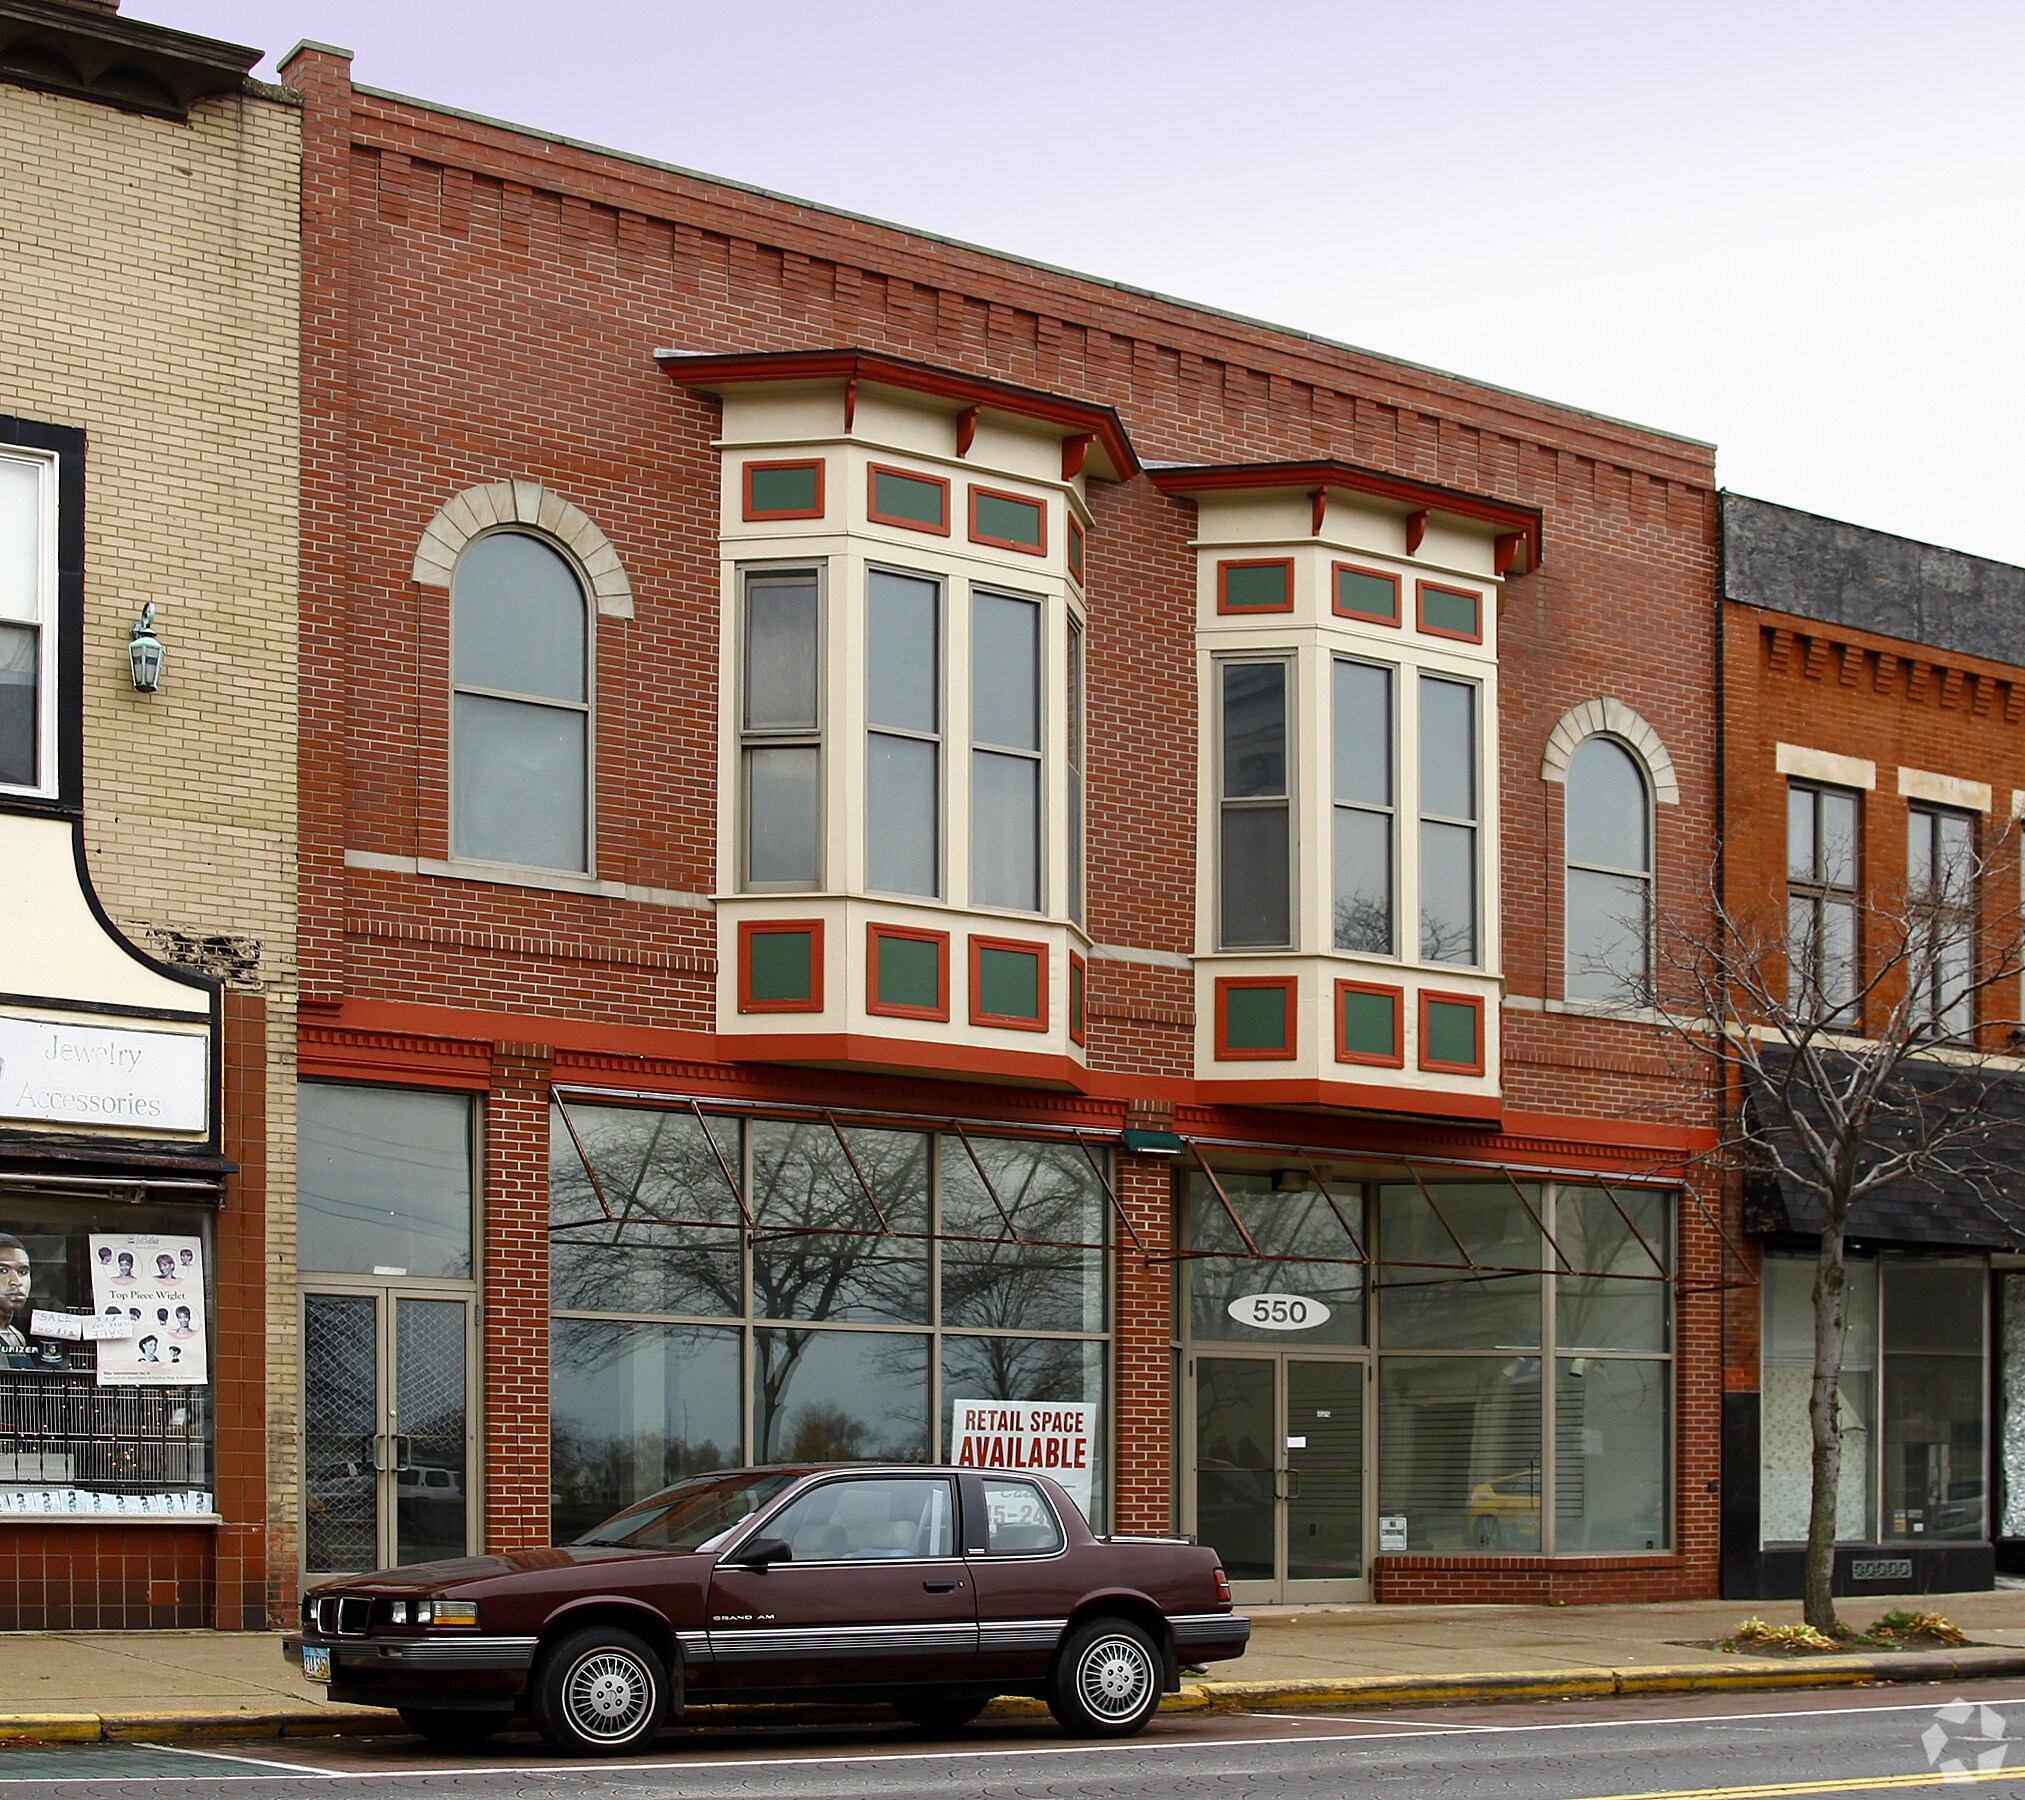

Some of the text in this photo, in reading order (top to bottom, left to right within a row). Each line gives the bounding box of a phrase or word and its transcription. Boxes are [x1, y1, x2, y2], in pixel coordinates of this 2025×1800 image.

[45, 1034, 141, 1073] Jewelry
[16, 1081, 161, 1117] Accessories
[109, 1290, 128, 1300] Top
[1253, 1300, 1307, 1323] 550
[0, 1345, 39, 1354] URIZER
[965, 1409, 1084, 1433] RETAIL SPACE
[958, 1436, 1087, 1468] AVAILABLE
